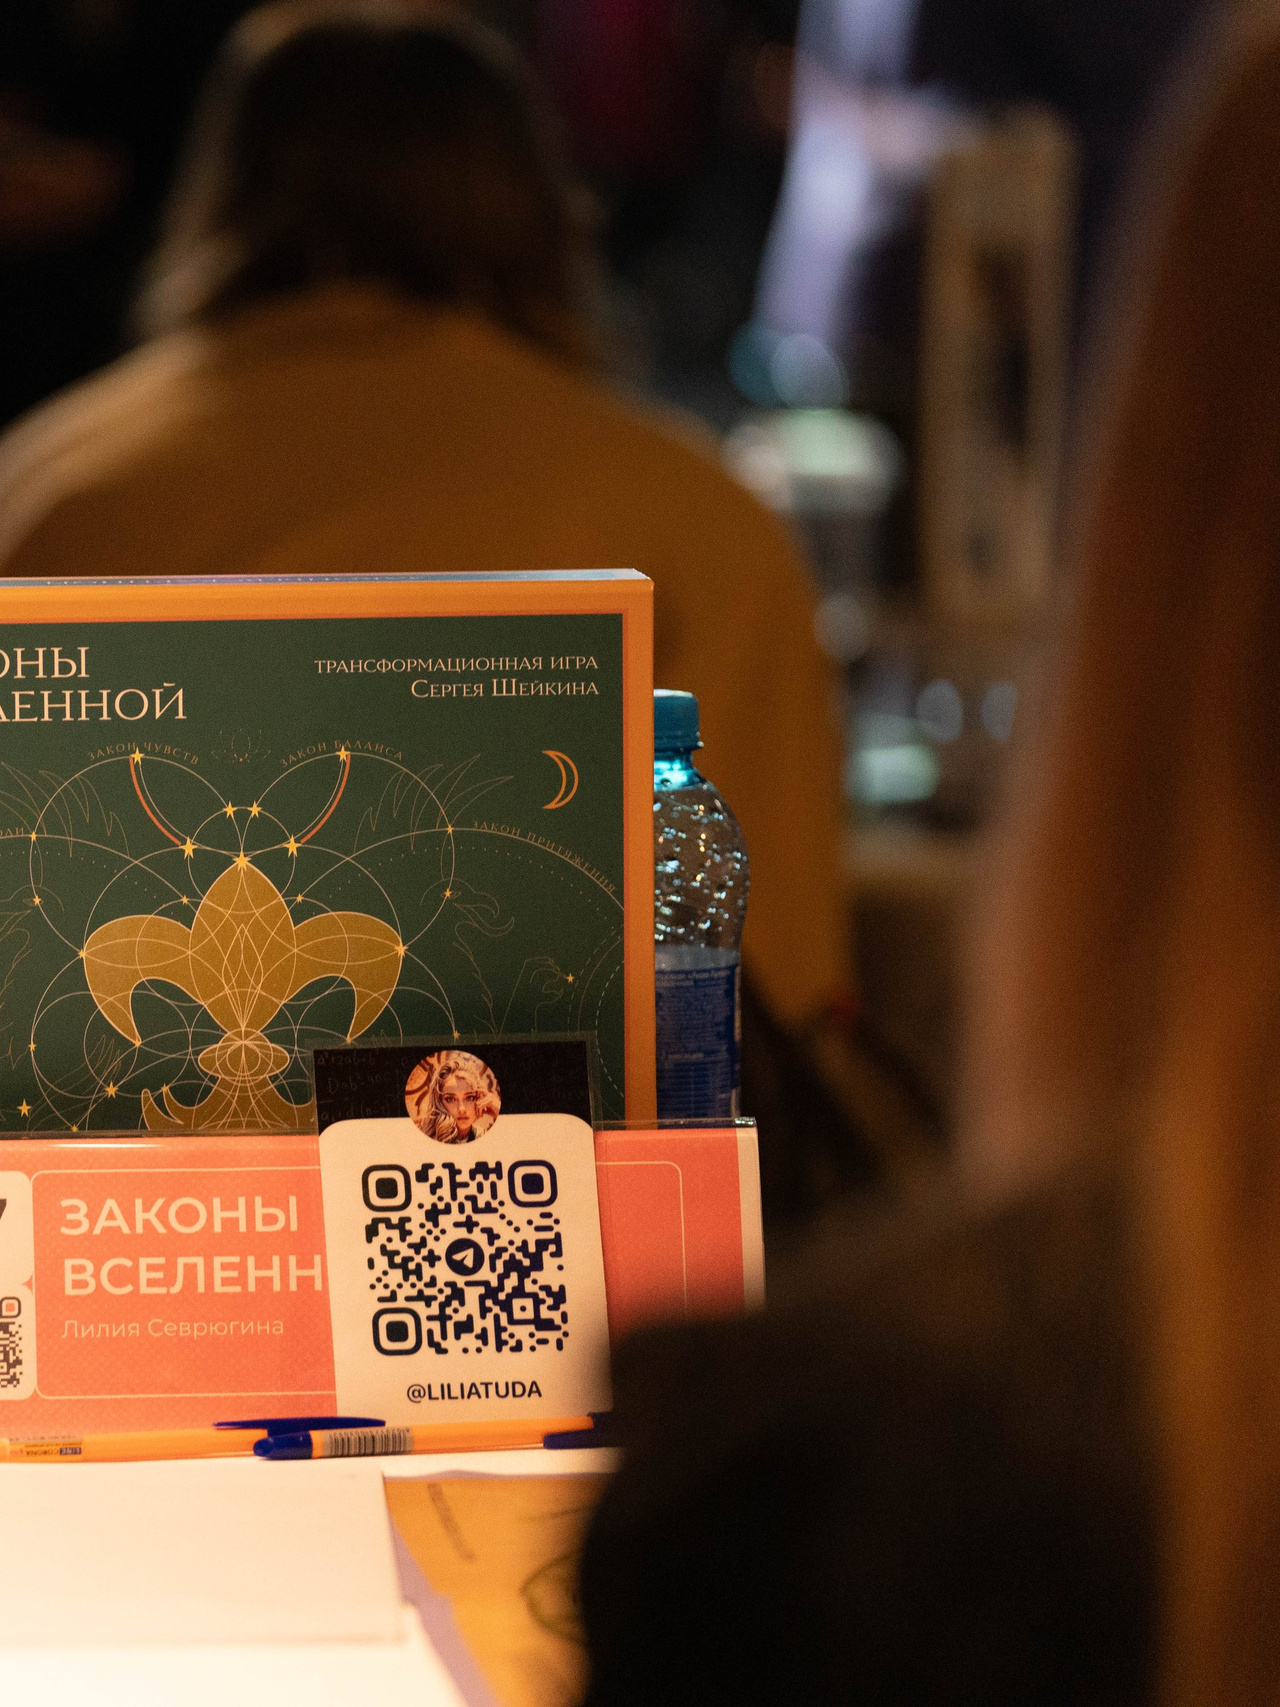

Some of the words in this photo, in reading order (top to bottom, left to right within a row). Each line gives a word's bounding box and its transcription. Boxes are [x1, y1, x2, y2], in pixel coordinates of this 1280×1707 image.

[314, 656, 543, 674] ТРАНСФОРМАЦИОННАЯ
[550, 655, 599, 671] ИГРА
[87, 741, 136, 761] ЗАКОН
[143, 741, 199, 765] ЧУВСТВ
[280, 741, 327, 767] ЗАКОН
[472, 821, 521, 838] ЗАКОН
[527, 832, 616, 893] ПРИТЯЖЕНИЯ
[60, 1195, 298, 1236] ЗАКОНЫ
[61, 1319, 140, 1339] Лилия
[148, 1318, 285, 1340] Севрюгина
[406, 1380, 543, 1404] @LILIATUDA
